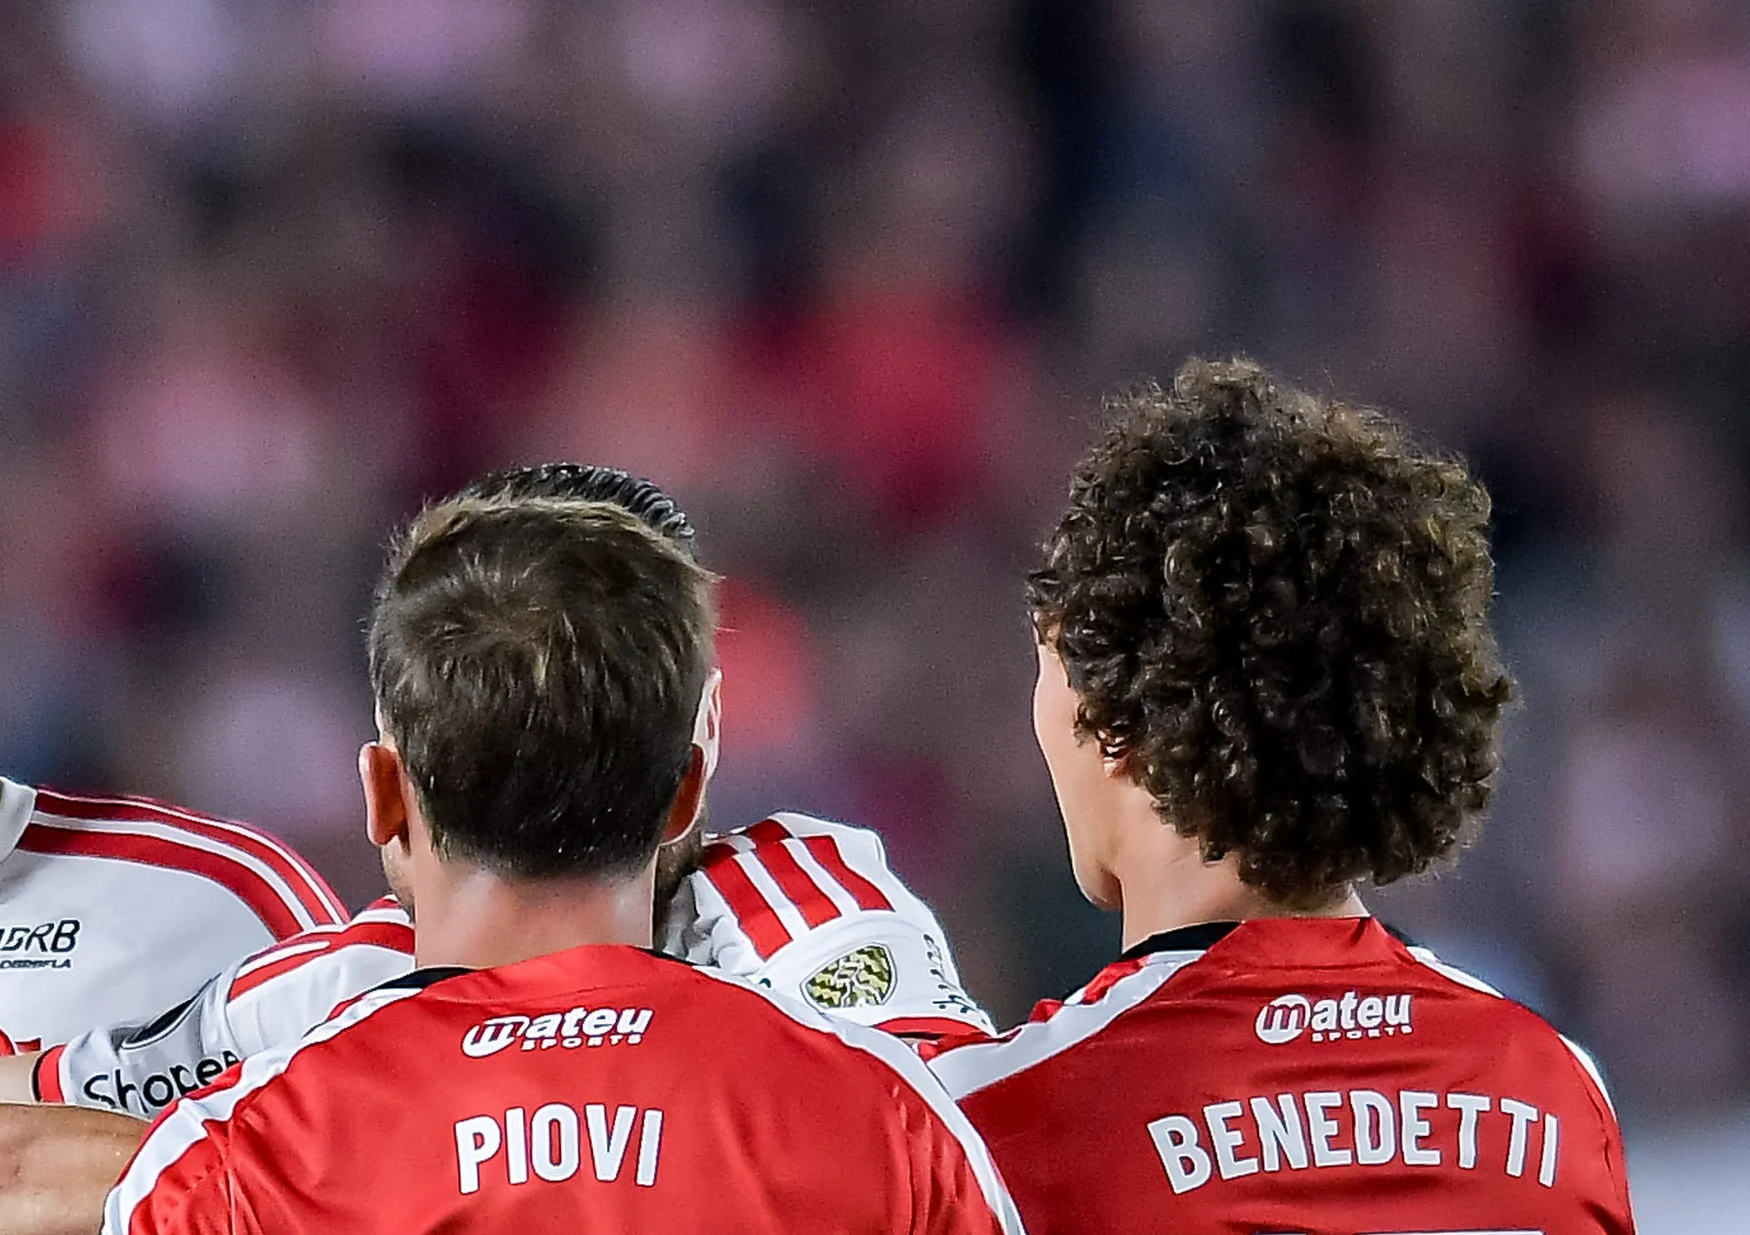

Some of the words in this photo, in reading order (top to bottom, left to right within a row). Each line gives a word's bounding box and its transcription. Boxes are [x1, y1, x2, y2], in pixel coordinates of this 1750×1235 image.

[462, 1007, 654, 1058] mateu
[1255, 991, 1411, 1044] mateu
[455, 1103, 663, 1194] PIOVI
[1147, 1090, 1557, 1194] BENEDETTI
